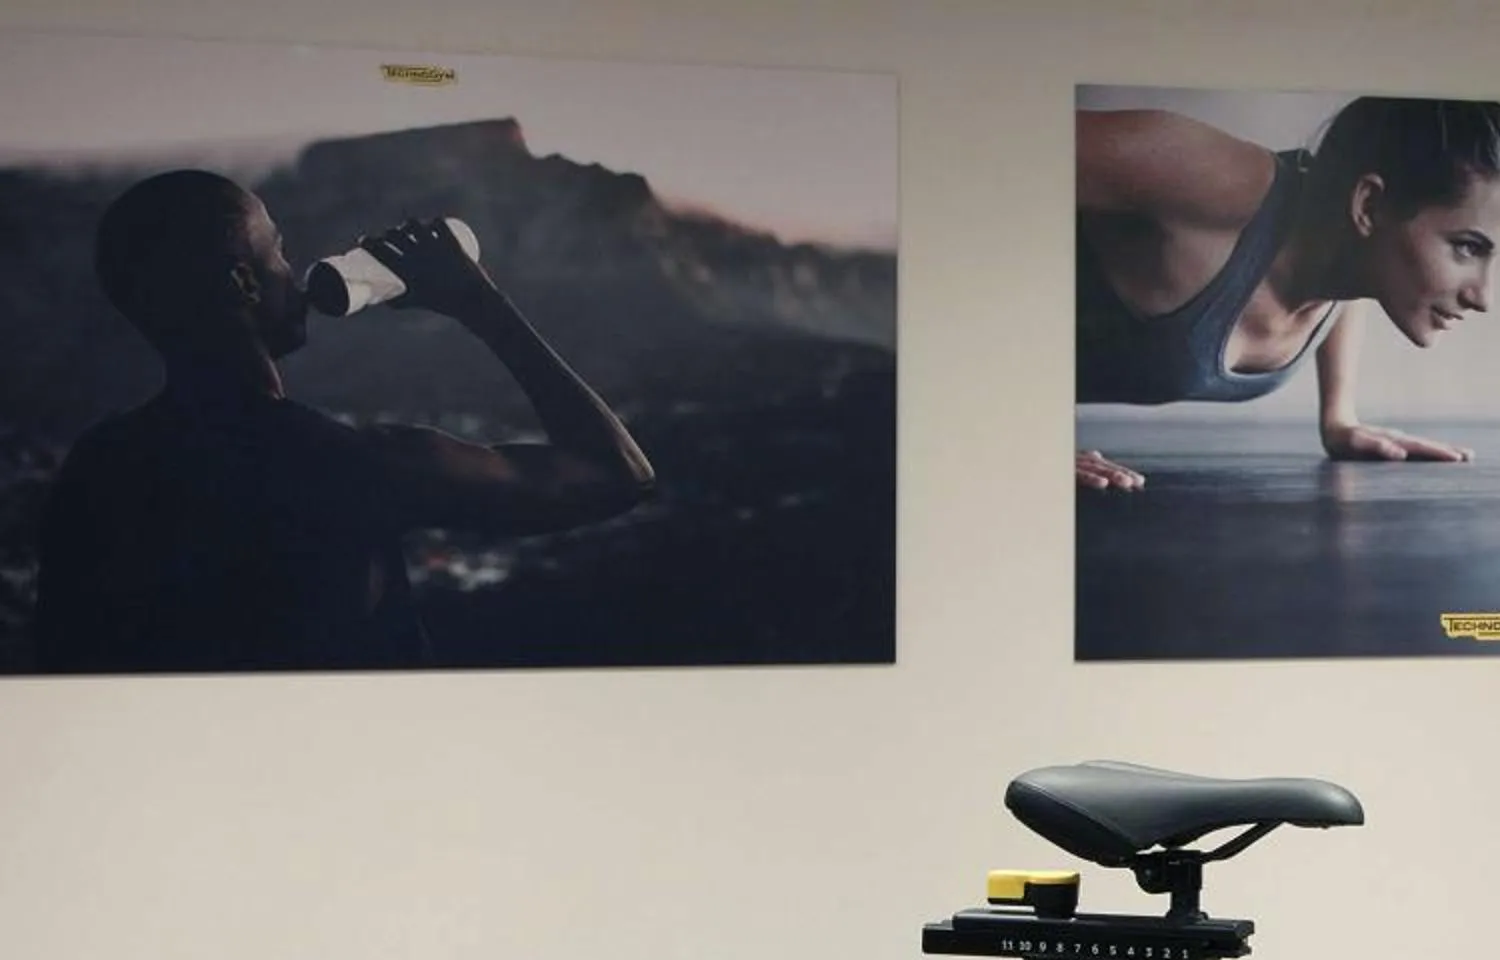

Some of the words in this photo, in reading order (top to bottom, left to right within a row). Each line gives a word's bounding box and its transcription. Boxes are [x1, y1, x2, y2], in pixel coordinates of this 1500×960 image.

[1002, 939, 1013, 951] 11
[1019, 940, 1032, 951] 10
[1039, 941, 1047, 952] 9
[1055, 942, 1064, 953] 8
[1073, 943, 1081, 954] 7
[1091, 943, 1099, 955] 6
[1109, 945, 1117, 956] 5
[1127, 945, 1135, 956] 4
[1145, 947, 1153, 958] 3
[1163, 947, 1171, 959] 2
[1181, 949, 1188, 960] 1
